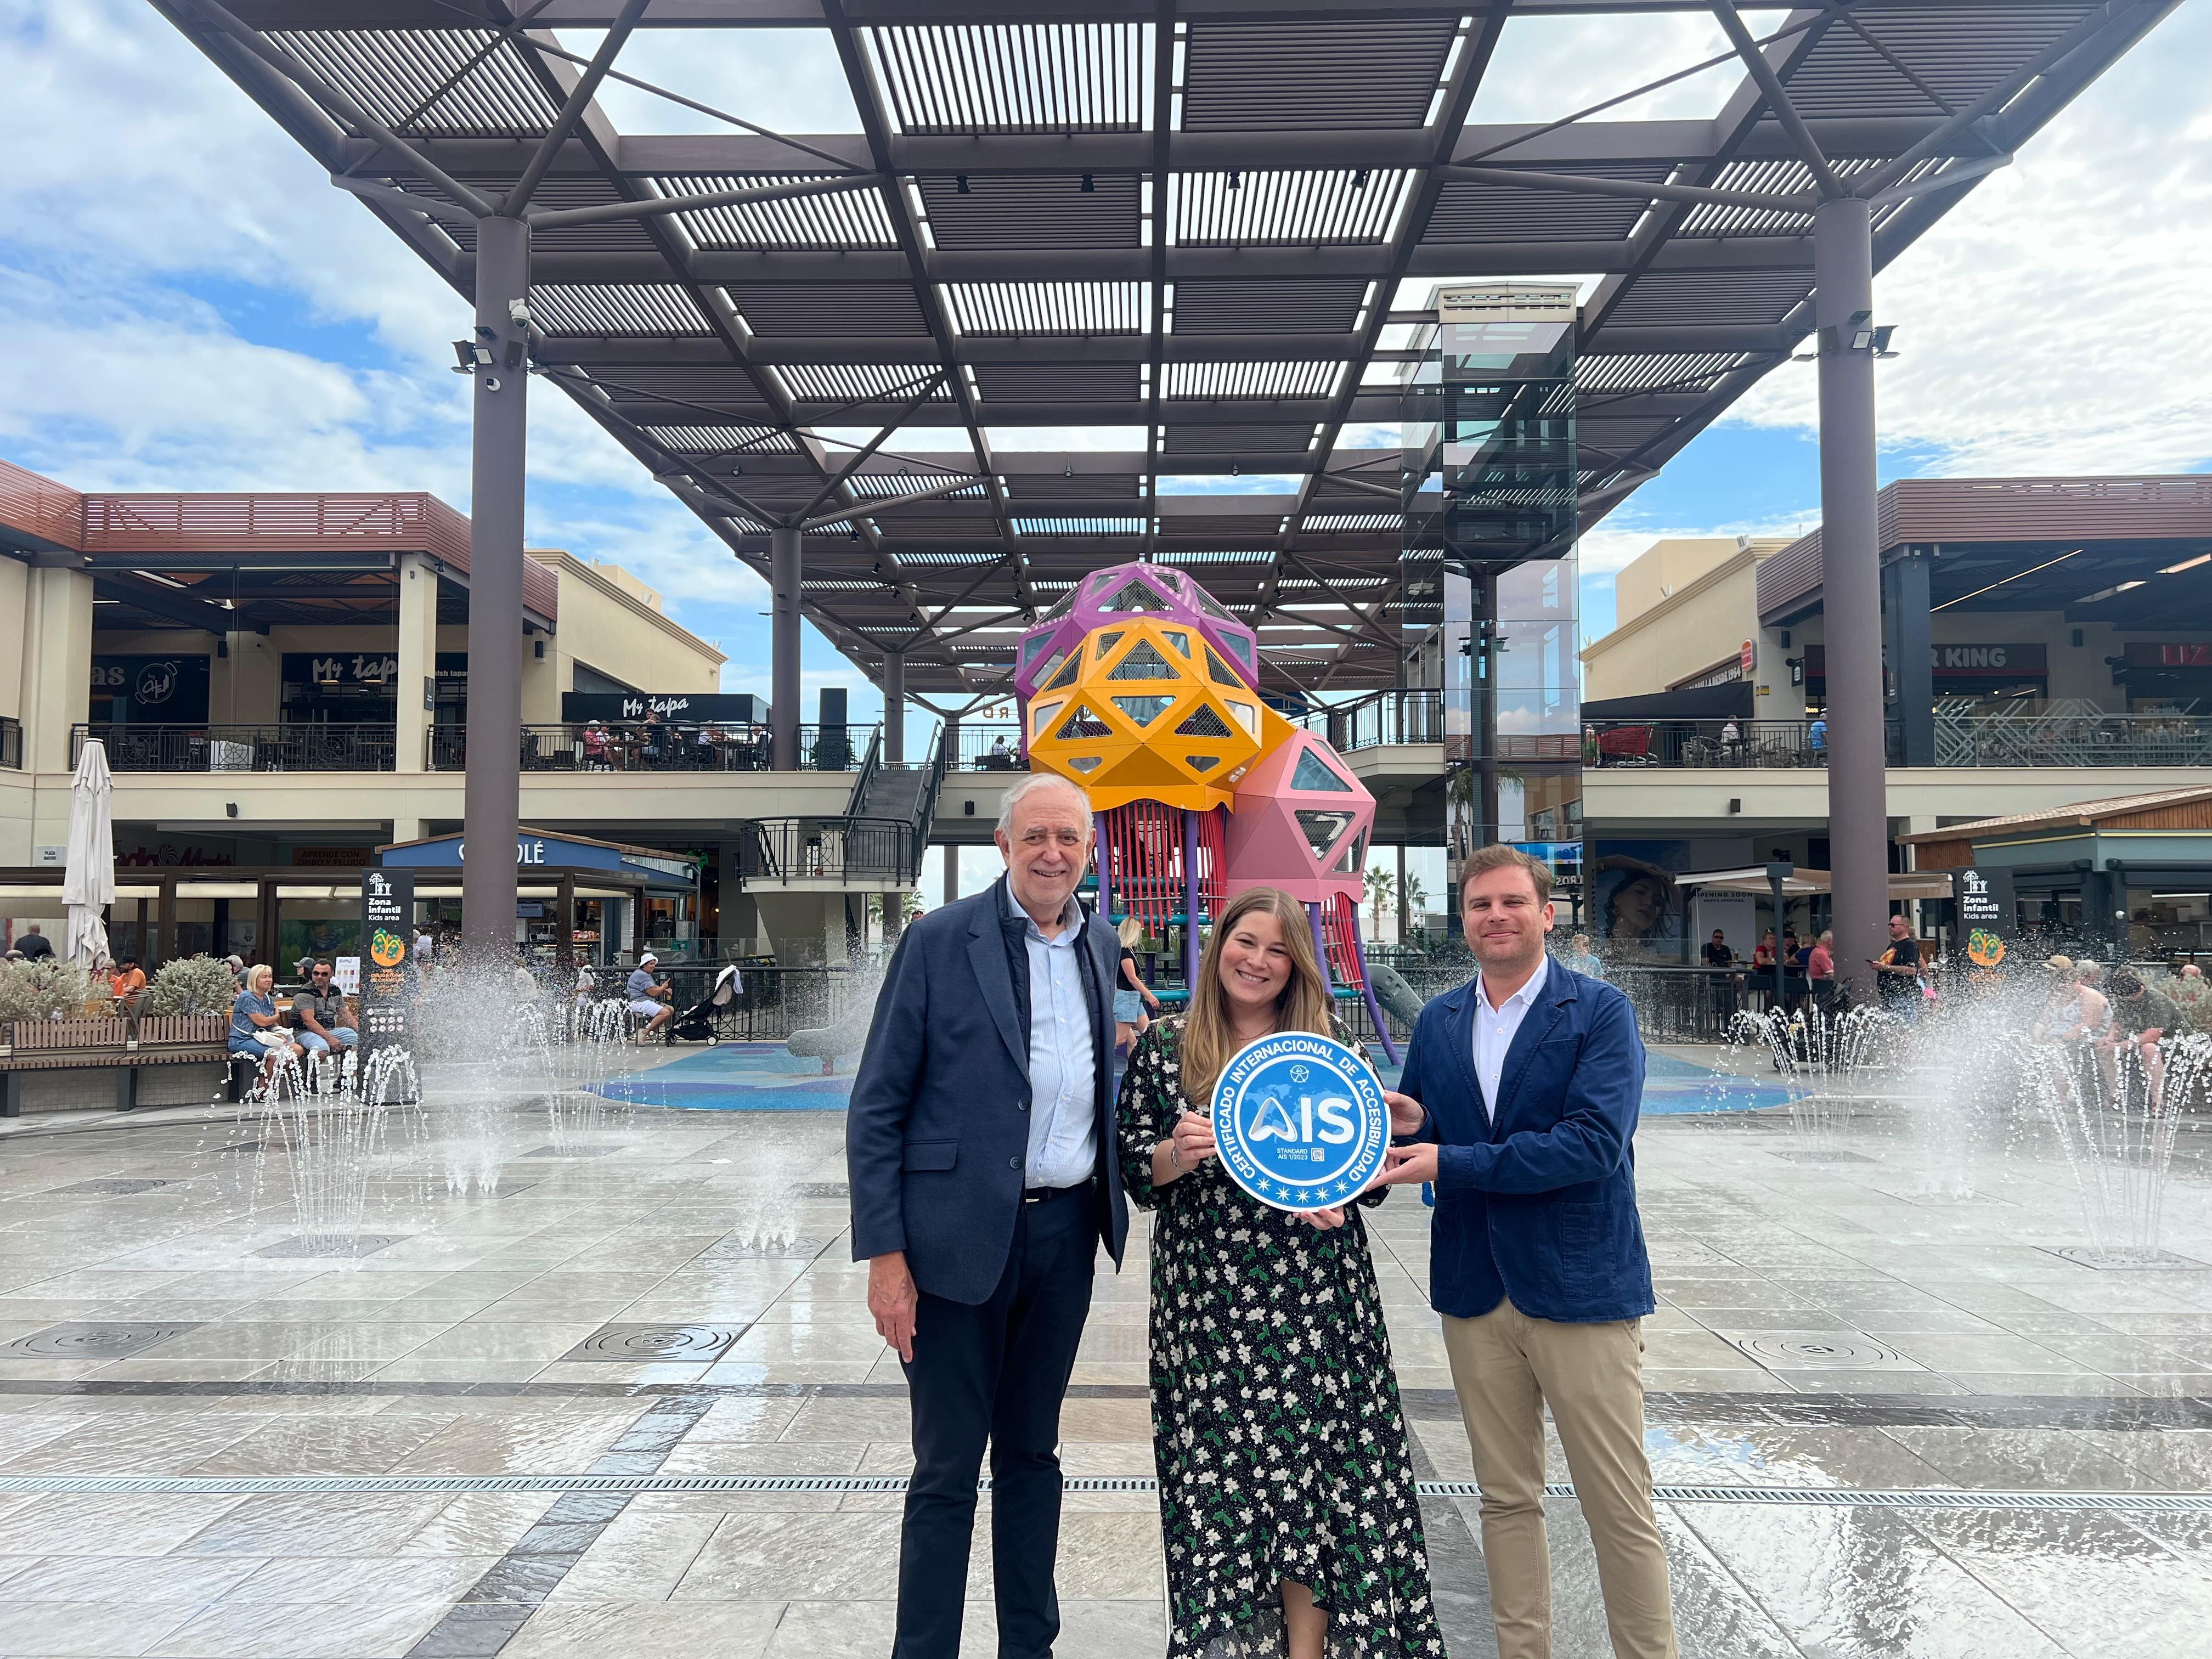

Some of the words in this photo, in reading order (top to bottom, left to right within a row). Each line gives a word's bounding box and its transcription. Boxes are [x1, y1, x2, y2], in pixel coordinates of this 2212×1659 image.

[1945, 647, 2006, 668] KING
[2162, 645, 2212, 665] LIZ
[91, 666, 126, 685] as
[312, 657, 343, 684] My
[351, 655, 398, 685] tap
[1712, 670, 1728, 686] DESDE
[1728, 665, 1741, 681] 1954
[623, 698, 644, 718] My
[648, 696, 689, 718] tapa
[1963, 904, 1999, 912] infantil
[1229, 1040, 1334, 1084] INTERNACIONAL
[1338, 1056, 1359, 1077] DE
[1248, 1097, 1355, 1144] AIS
[1348, 1078, 1382, 1182] ACCESIBILIDAD
[1219, 1086, 1256, 1180] CERTIFICADO
